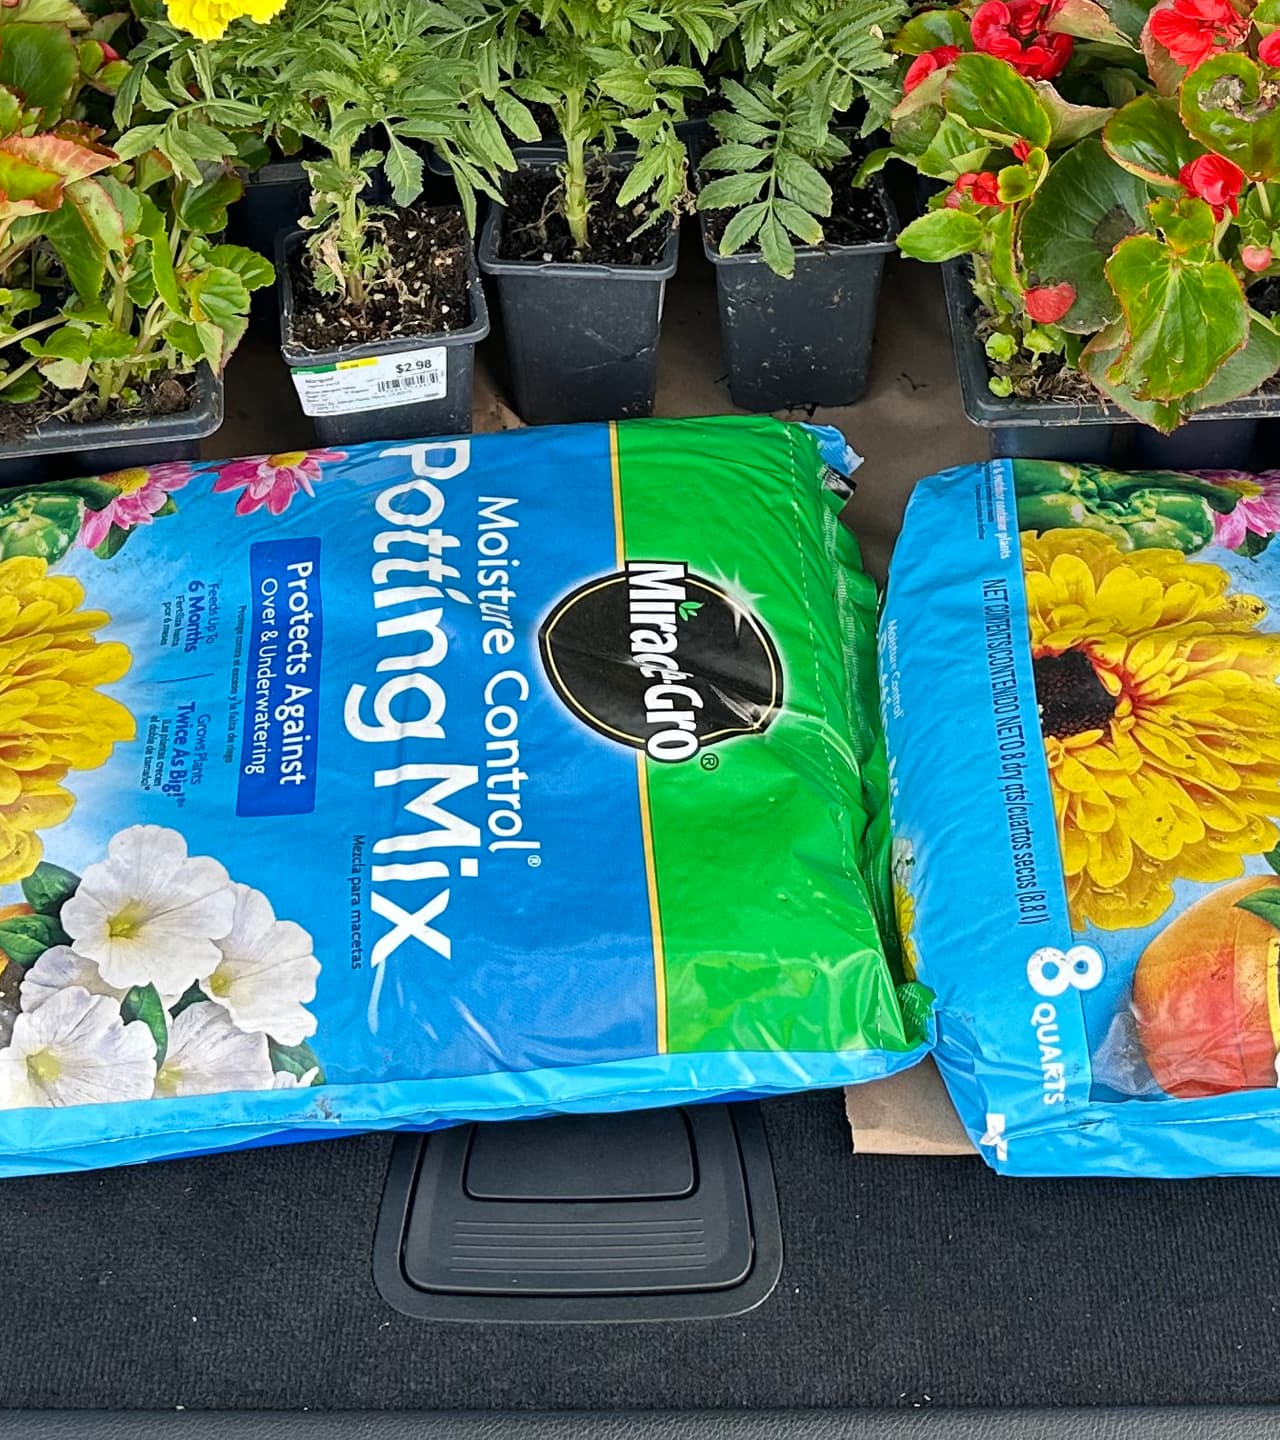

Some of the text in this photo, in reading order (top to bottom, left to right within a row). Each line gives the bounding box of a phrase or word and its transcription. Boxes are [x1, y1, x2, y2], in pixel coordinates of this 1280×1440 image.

[395, 359, 432, 374] $2.98
[994, 533, 1012, 559] plants
[344, 439, 473, 742] Potting
[477, 496, 520, 654] Moisture
[982, 578, 1009, 603] NET
[161, 601, 172, 616] por
[184, 580, 205, 653] 6 Months
[204, 583, 220, 644] Feeds Up To
[245, 578, 278, 775] Over & Underwatering
[274, 561, 314, 785] Protects Against
[174, 701, 196, 745] Twice
[227, 733, 238, 743] de
[997, 715, 1025, 750] NETO
[170, 748, 191, 766] As
[190, 713, 211, 785] Grows Plants
[997, 762, 1028, 780] dry
[1001, 752, 1026, 760] 8
[999, 783, 1034, 850] qts/cuartos
[370, 763, 481, 968] Mix
[1013, 852, 1037, 889] secos
[347, 834, 366, 970] Mezcla para macetas
[1014, 890, 1047, 912] (8.8
[1026, 945, 1104, 996] 8
[1030, 1002, 1066, 1104] QUARTS
